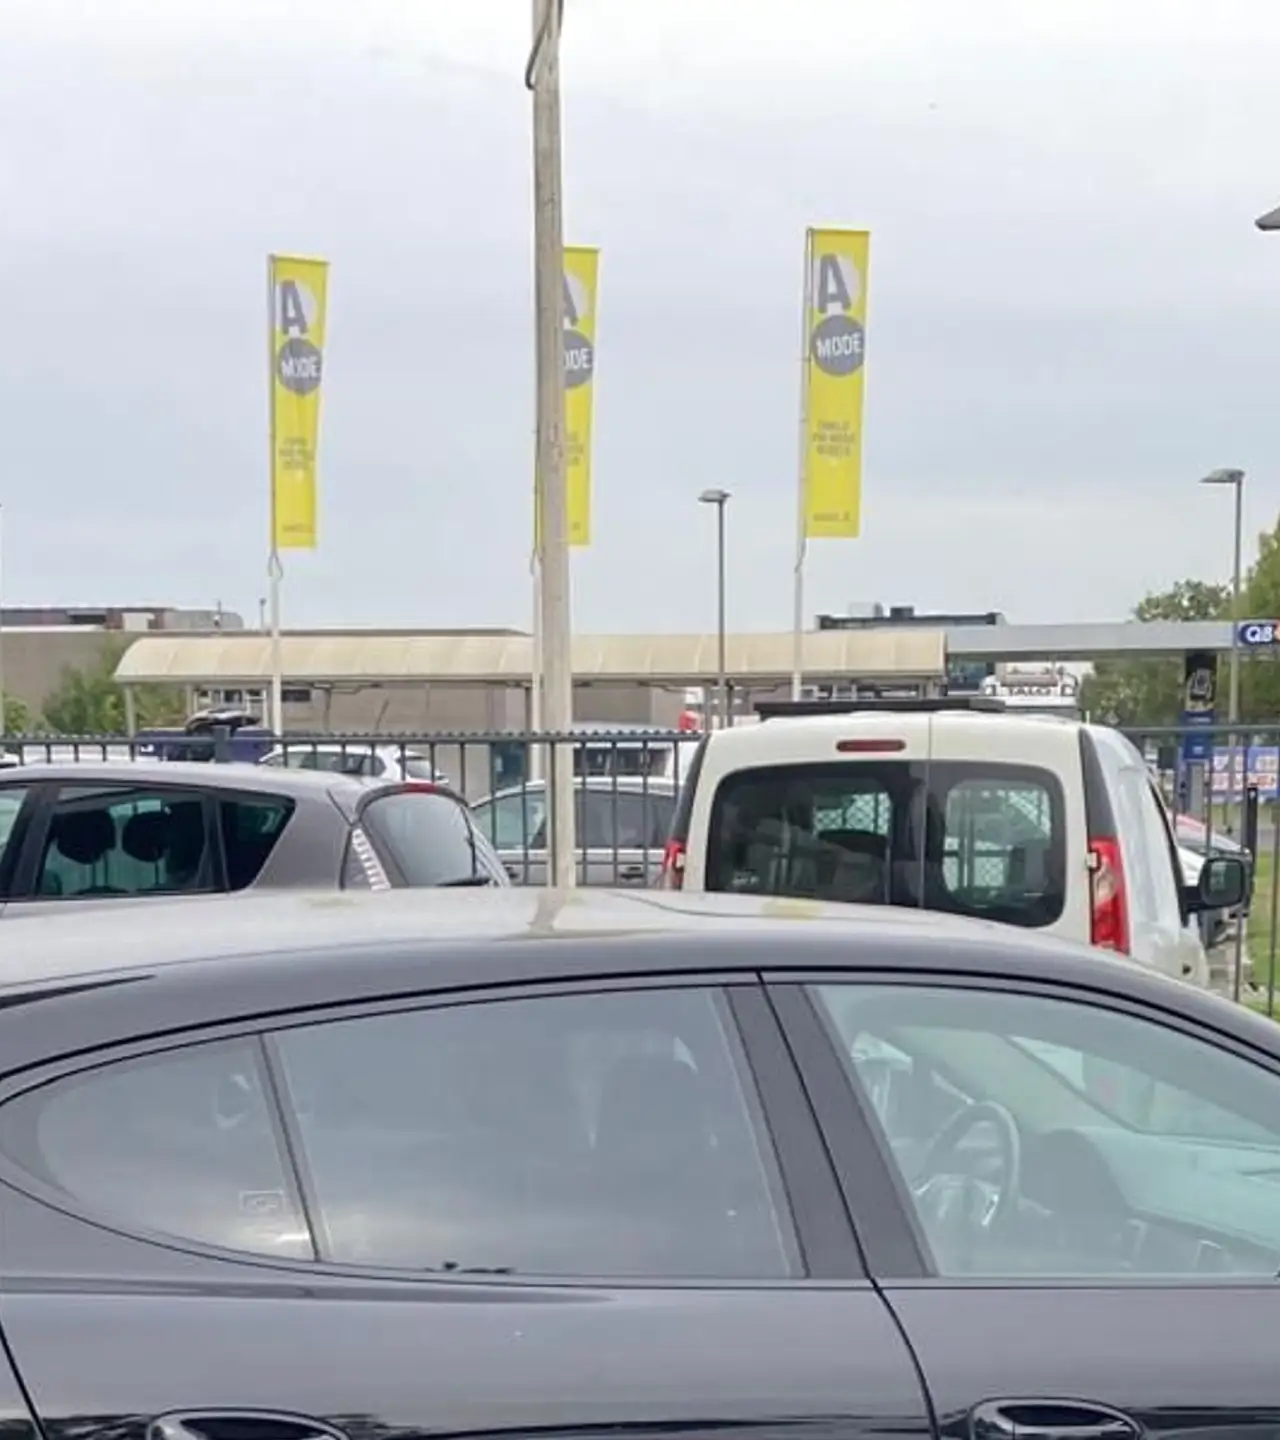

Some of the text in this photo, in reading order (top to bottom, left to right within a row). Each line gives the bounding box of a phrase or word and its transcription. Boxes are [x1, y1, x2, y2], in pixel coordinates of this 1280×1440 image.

[818, 253, 852, 313] A
[281, 279, 308, 336] A
[816, 332, 863, 359] MODE
[282, 356, 320, 378] MODE
[563, 347, 592, 369] ODE
[1246, 625, 1273, 642] Q8
